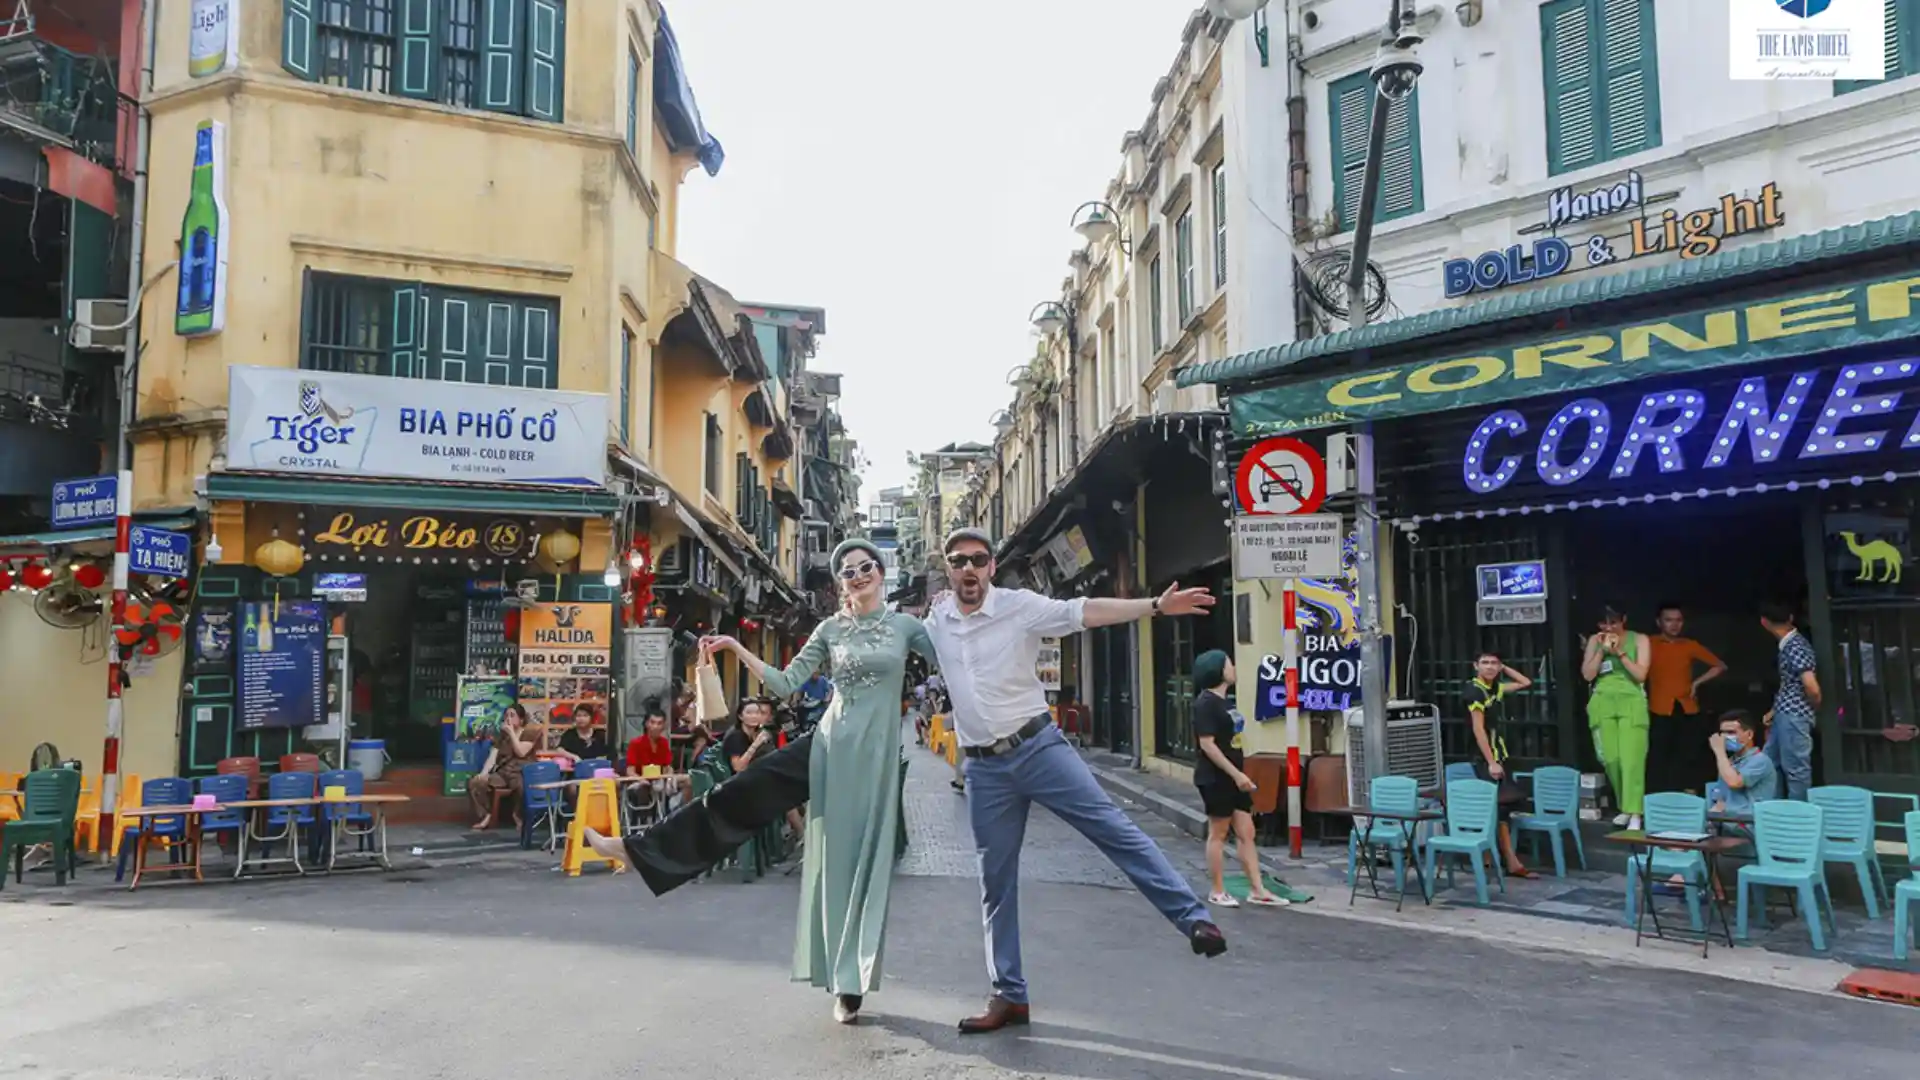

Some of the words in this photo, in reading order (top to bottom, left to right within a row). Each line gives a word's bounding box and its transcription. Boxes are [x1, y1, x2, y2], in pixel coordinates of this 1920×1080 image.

[1550, 169, 1643, 224] Hanoi
[1443, 236, 1572, 299] BOLD
[1588, 235, 1617, 266] &
[1630, 181, 1786, 260] Light
[266, 414, 355, 454] Tiger
[400, 407, 447, 436] BIA
[457, 407, 516, 439] PHỐ
[521, 409, 558, 442] CỔ
[1463, 357, 1920, 493] CORNE
[279, 456, 340, 469] CRYSTAL
[422, 444, 440, 456] BIA
[480, 448, 506, 460] COLD
[509, 450, 534, 461] BEER
[75, 483, 97, 497] PHỐ
[314, 513, 388, 552] Lợi
[401, 516, 477, 548] Béo
[491, 525, 519, 543] 18
[136, 548, 152, 568] TẠ
[155, 549, 182, 571] HIỆN
[1271, 551, 1297, 562] NGOẠI
[1274, 563, 1306, 575] Except
[535, 629, 594, 643] HALIDA
[1305, 635, 1340, 652] BIA
[523, 654, 546, 664] BIA
[578, 652, 605, 664] BÉO
[1260, 654, 1361, 687] SIGO
